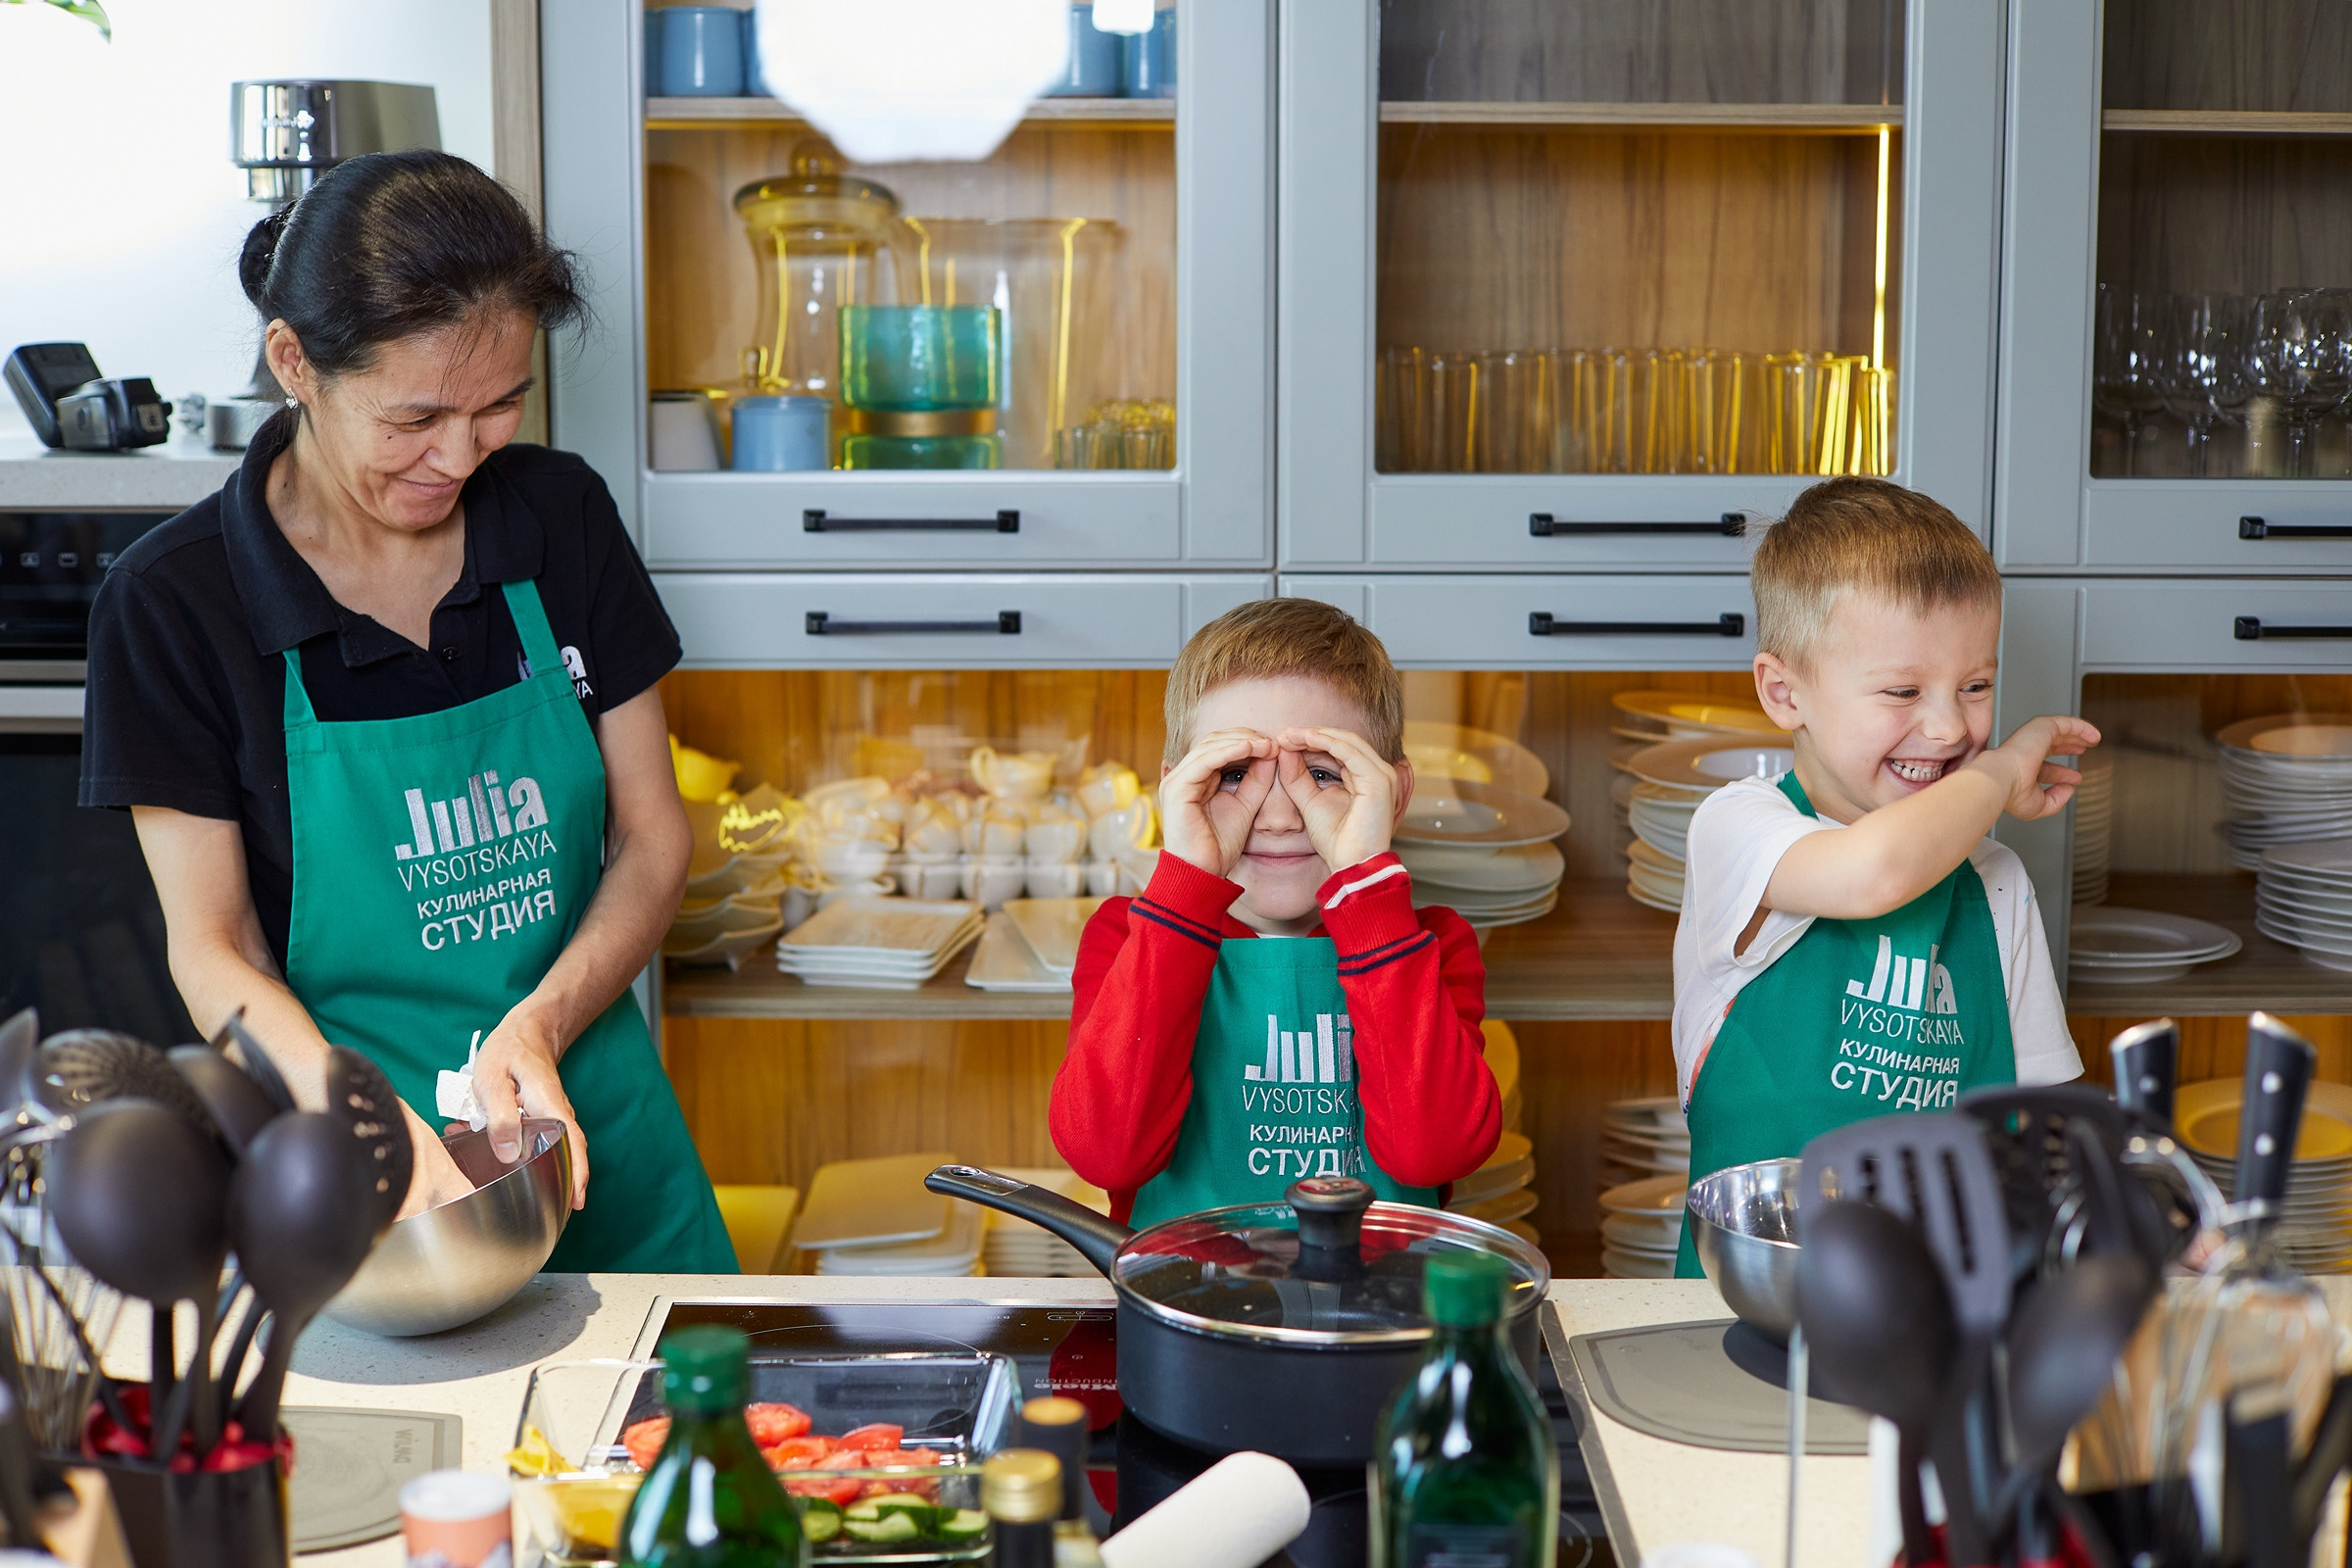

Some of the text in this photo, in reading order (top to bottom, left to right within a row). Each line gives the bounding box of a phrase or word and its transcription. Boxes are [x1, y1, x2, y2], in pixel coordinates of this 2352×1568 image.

[395, 769, 549, 860] Julia
[397, 830, 557, 892] VYSOTSKAYA
[416, 868, 552, 919] КУЛИНАРНАЯ
[421, 889, 556, 951] СТУДИЯ
[1841, 999, 1964, 1045] VYSOTSKAYA
[1245, 1013, 1351, 1083] Juli
[1839, 1038, 1960, 1074] КУЛИНАРНАЯ
[1242, 1085, 1356, 1114] VYSOTSK
[1831, 1061, 1958, 1112] СТУДИЯ
